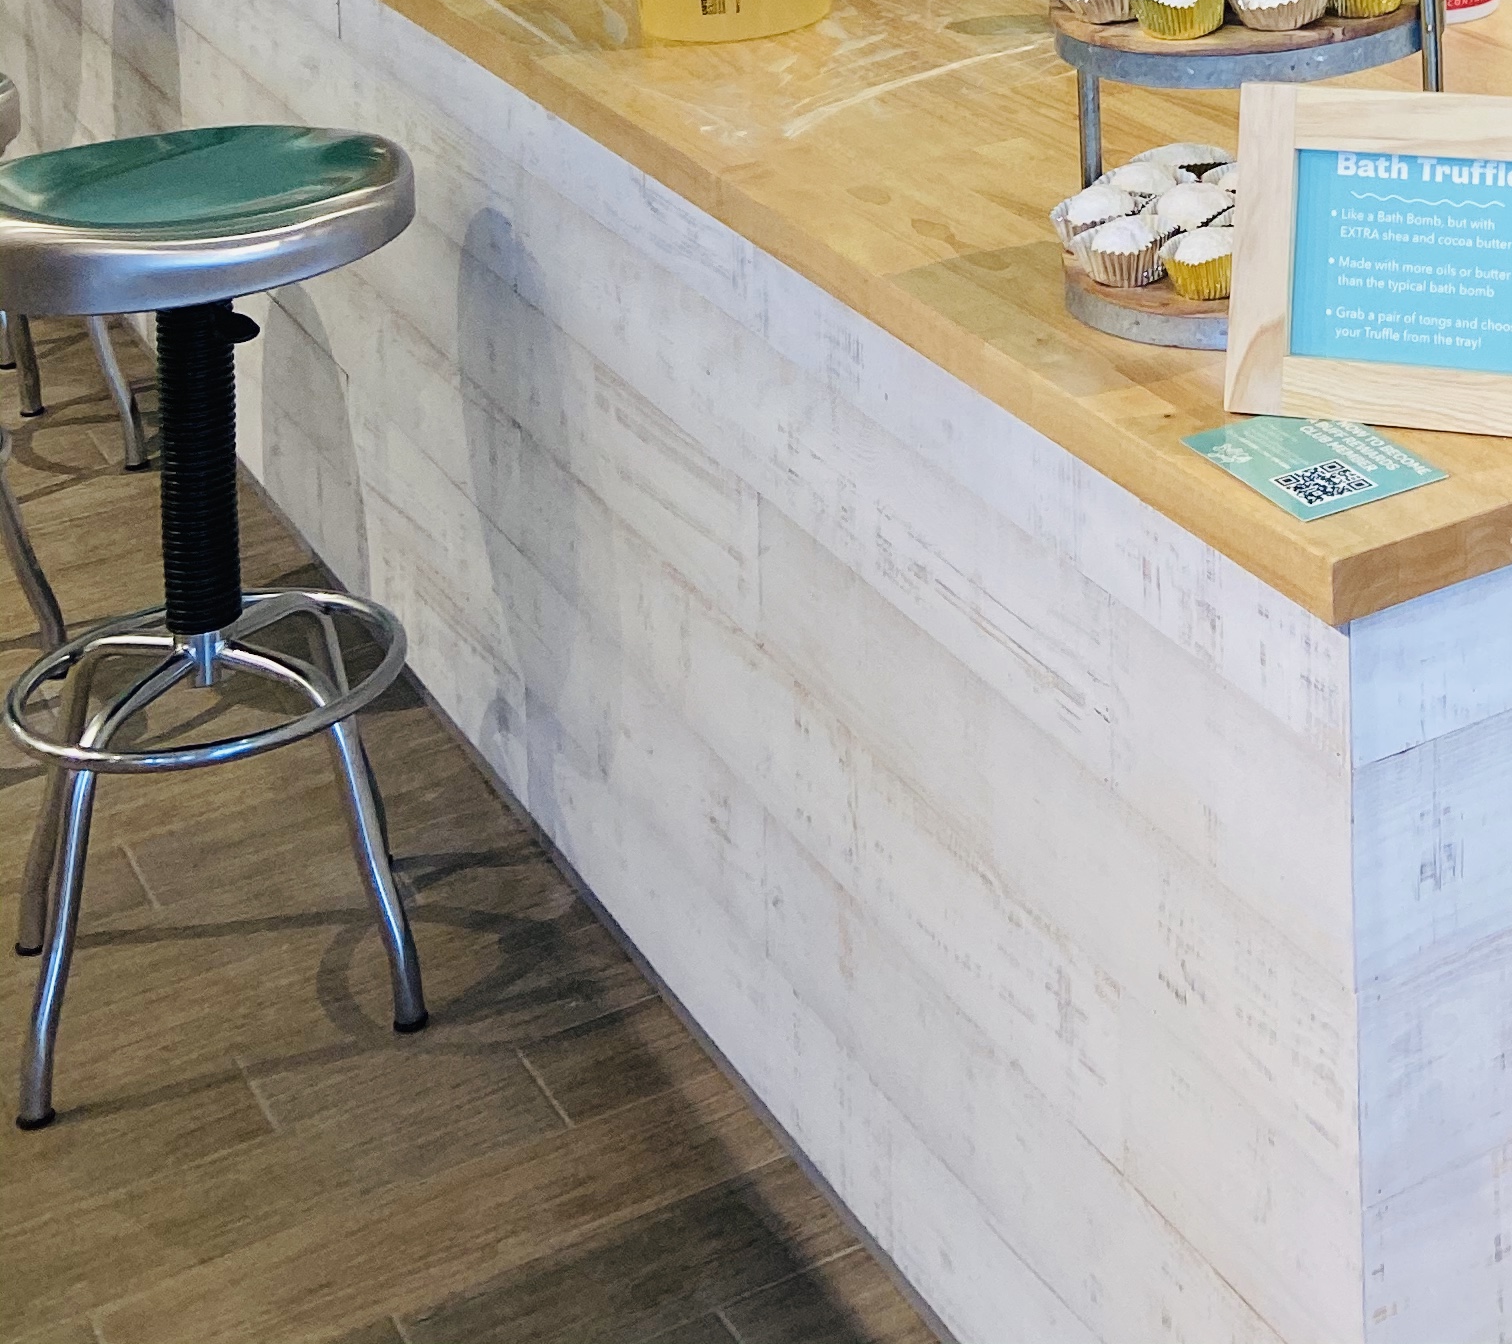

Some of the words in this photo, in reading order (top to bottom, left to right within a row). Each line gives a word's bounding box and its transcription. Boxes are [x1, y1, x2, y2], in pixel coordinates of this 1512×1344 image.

[1337, 152, 1409, 180] Bath
[1341, 208, 1364, 222] Like
[1366, 213, 1374, 222] a
[1377, 210, 1403, 224] Bath
[1406, 212, 1444, 228] Bomb,
[1447, 215, 1467, 229] but
[1470, 218, 1496, 231] with
[1340, 225, 1380, 241] EXTRA
[1382, 230, 1410, 243] shea
[1412, 232, 1435, 245] and
[1438, 236, 1473, 248] cocoa
[1476, 235, 1512, 251] butter
[1338, 255, 1372, 270] Made
[1375, 258, 1399, 272] with
[1402, 263, 1433, 275] more
[1436, 263, 1457, 277] oils
[1459, 268, 1472, 278] or
[1475, 266, 1511, 281] butter
[1337, 275, 1363, 288] than
[1366, 276, 1385, 289] the
[1387, 279, 1426, 294] typical
[1429, 281, 1456, 295] bath
[1459, 283, 1496, 298] bomb
[1335, 306, 1365, 321] Grab
[1367, 311, 1375, 321] a
[1377, 310, 1401, 324] pair
[1403, 311, 1417, 324] of
[1419, 313, 1452, 330] tongs
[1455, 317, 1478, 331] and
[1335, 327, 1361, 339] your
[1364, 326, 1400, 342] Truffle
[1403, 330, 1431, 343] from
[1433, 333, 1453, 346] the
[1455, 336, 1483, 352] tray!
[1299, 425, 1333, 444] CLUB
[1327, 441, 1379, 472] MEMBER
[1342, 436, 1400, 471] REWARDS
[1379, 444, 1433, 476] BECOME
